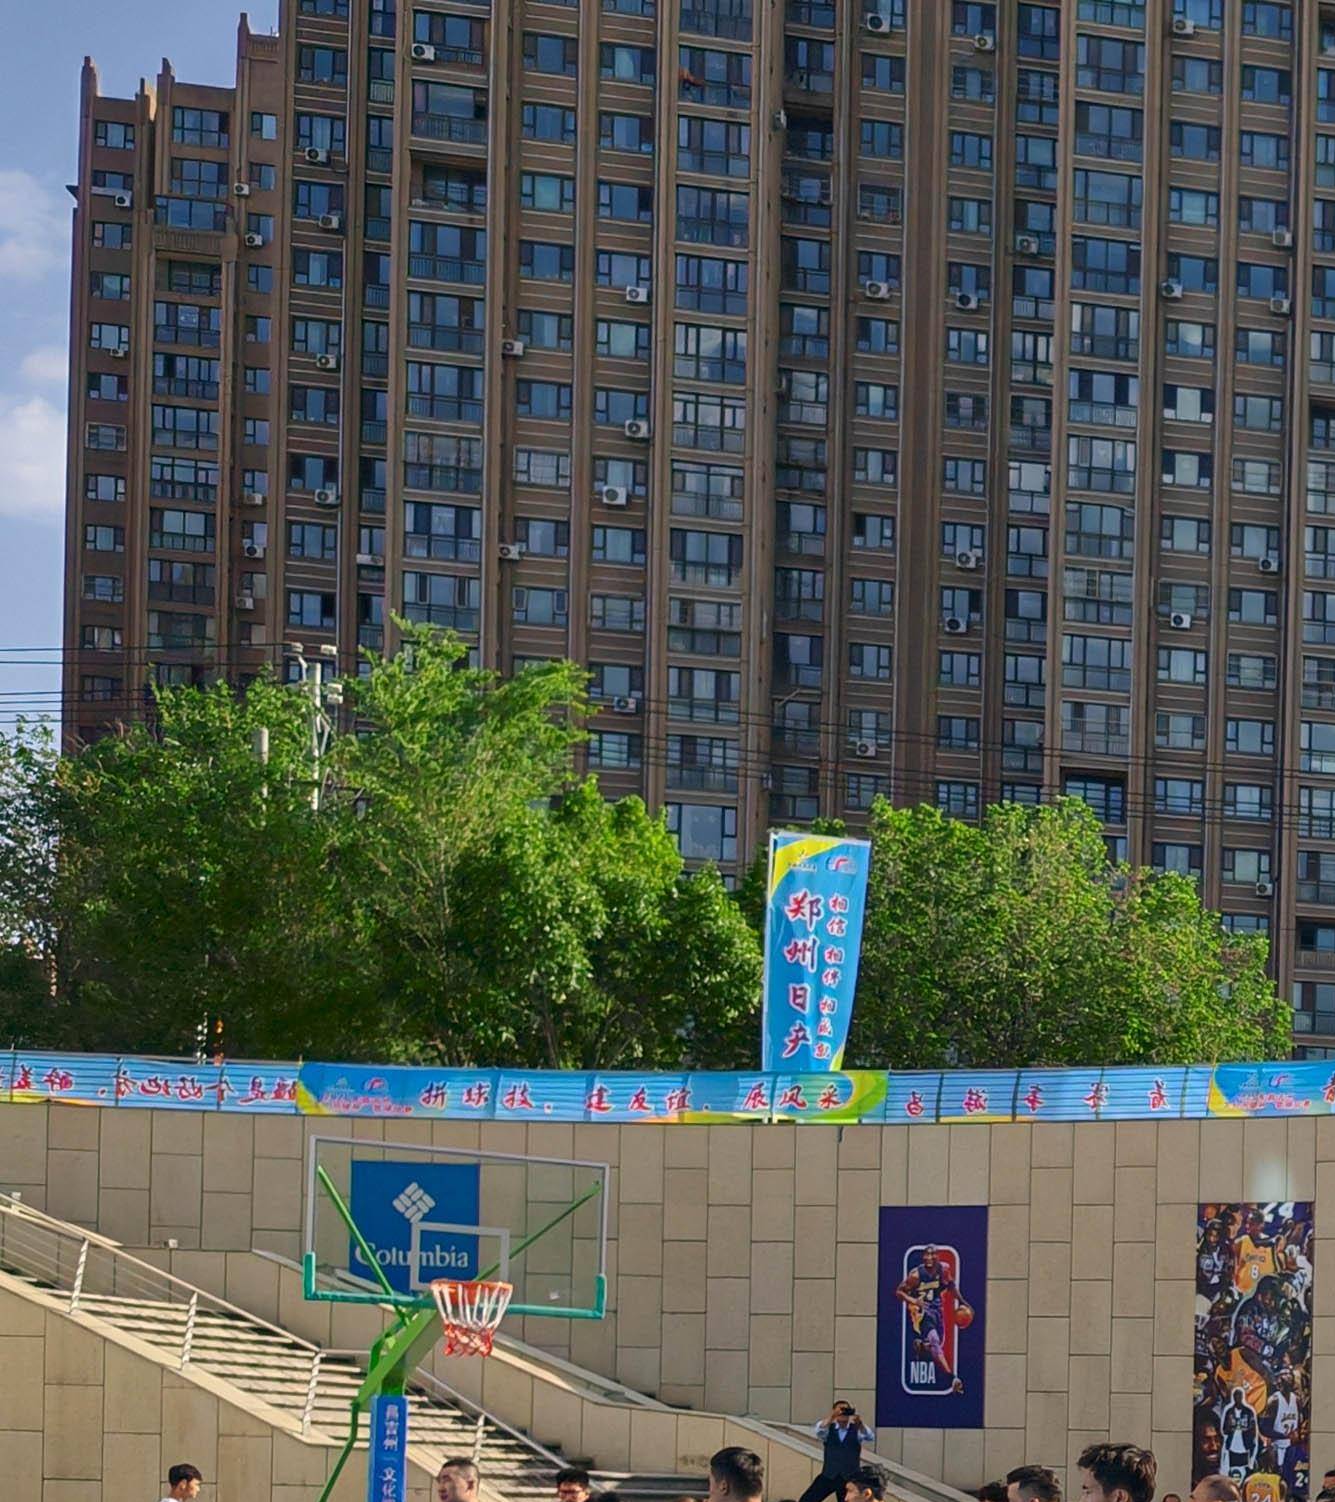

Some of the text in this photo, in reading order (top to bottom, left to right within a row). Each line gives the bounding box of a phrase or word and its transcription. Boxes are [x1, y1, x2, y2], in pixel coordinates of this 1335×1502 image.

[782, 888, 824, 1060] 郑州日产
[910, 1361, 936, 1384] NBA
